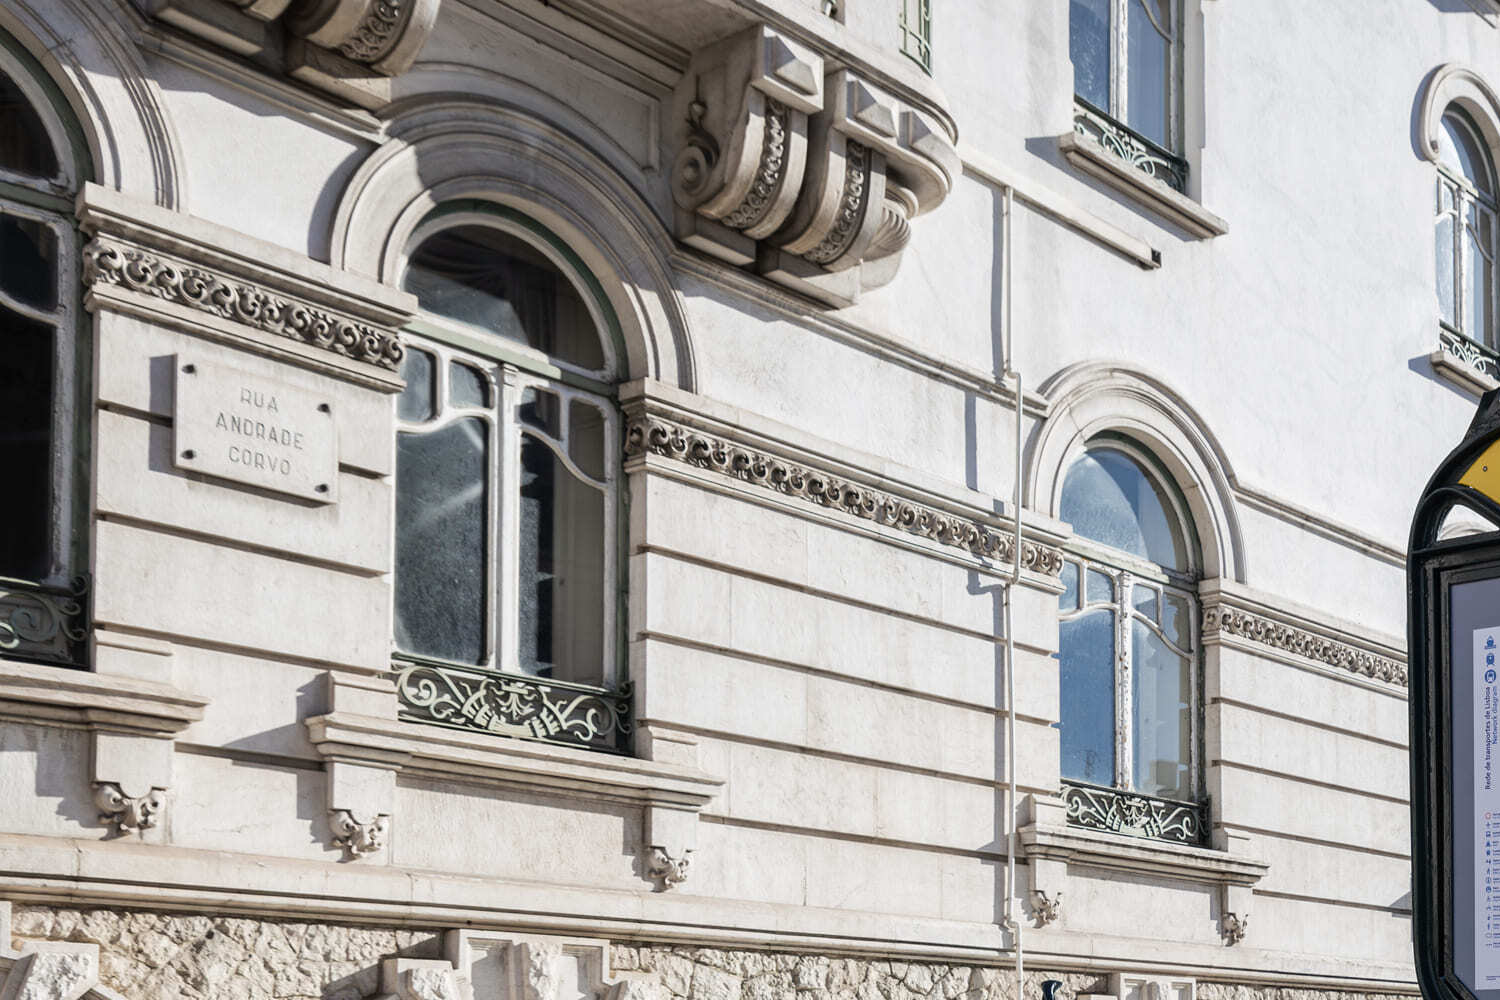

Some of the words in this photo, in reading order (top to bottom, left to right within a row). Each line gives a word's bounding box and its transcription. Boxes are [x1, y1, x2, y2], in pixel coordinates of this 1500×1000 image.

[240, 387, 279, 413] RUA
[215, 412, 305, 450] ANDRADE
[228, 445, 291, 476] CORVO
[1491, 686, 1499, 713] diagram
[1484, 711, 1491, 719] de
[1484, 721, 1492, 760] transportes
[1484, 762, 1491, 771] de
